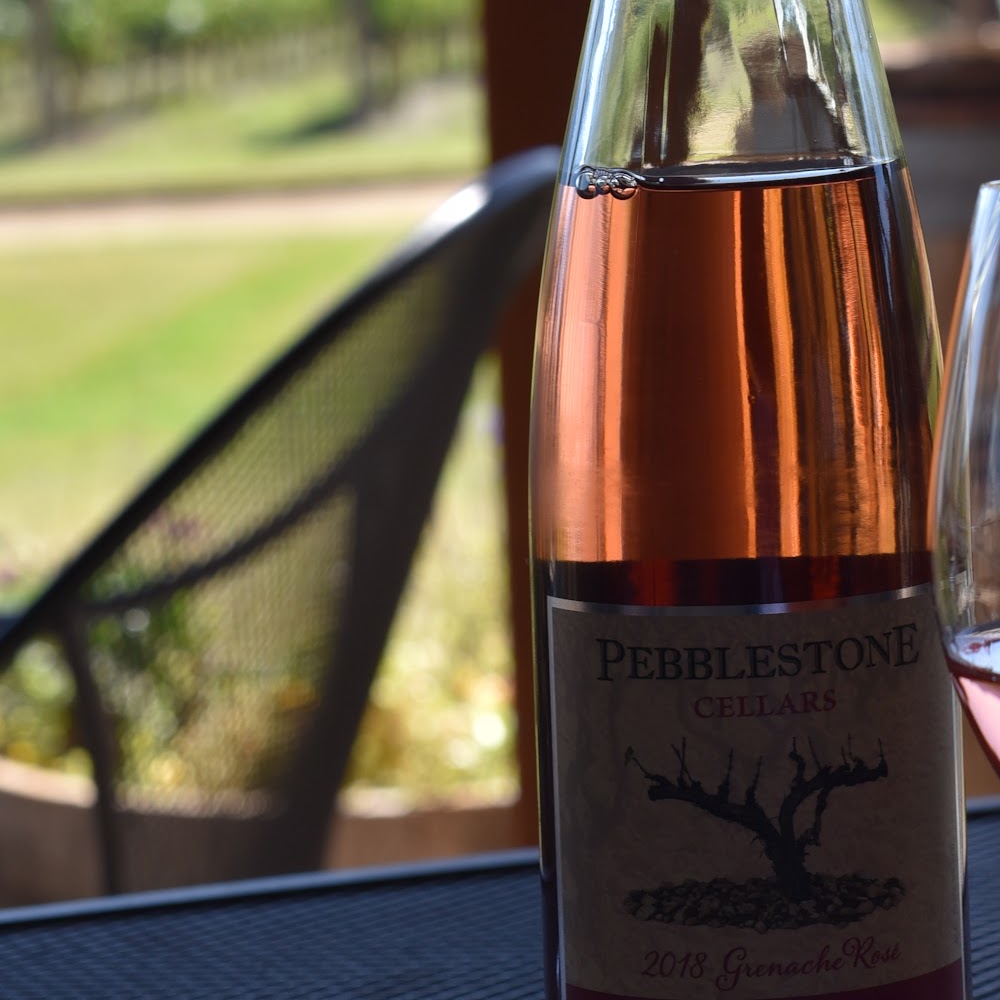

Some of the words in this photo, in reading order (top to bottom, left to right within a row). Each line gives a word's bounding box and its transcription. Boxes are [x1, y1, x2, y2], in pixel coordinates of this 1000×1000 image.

[596, 623, 920, 681] PEBBLESTONE
[693, 688, 838, 719] CELLARS
[641, 950, 708, 979] 2018
[714, 946, 845, 992] Grenache
